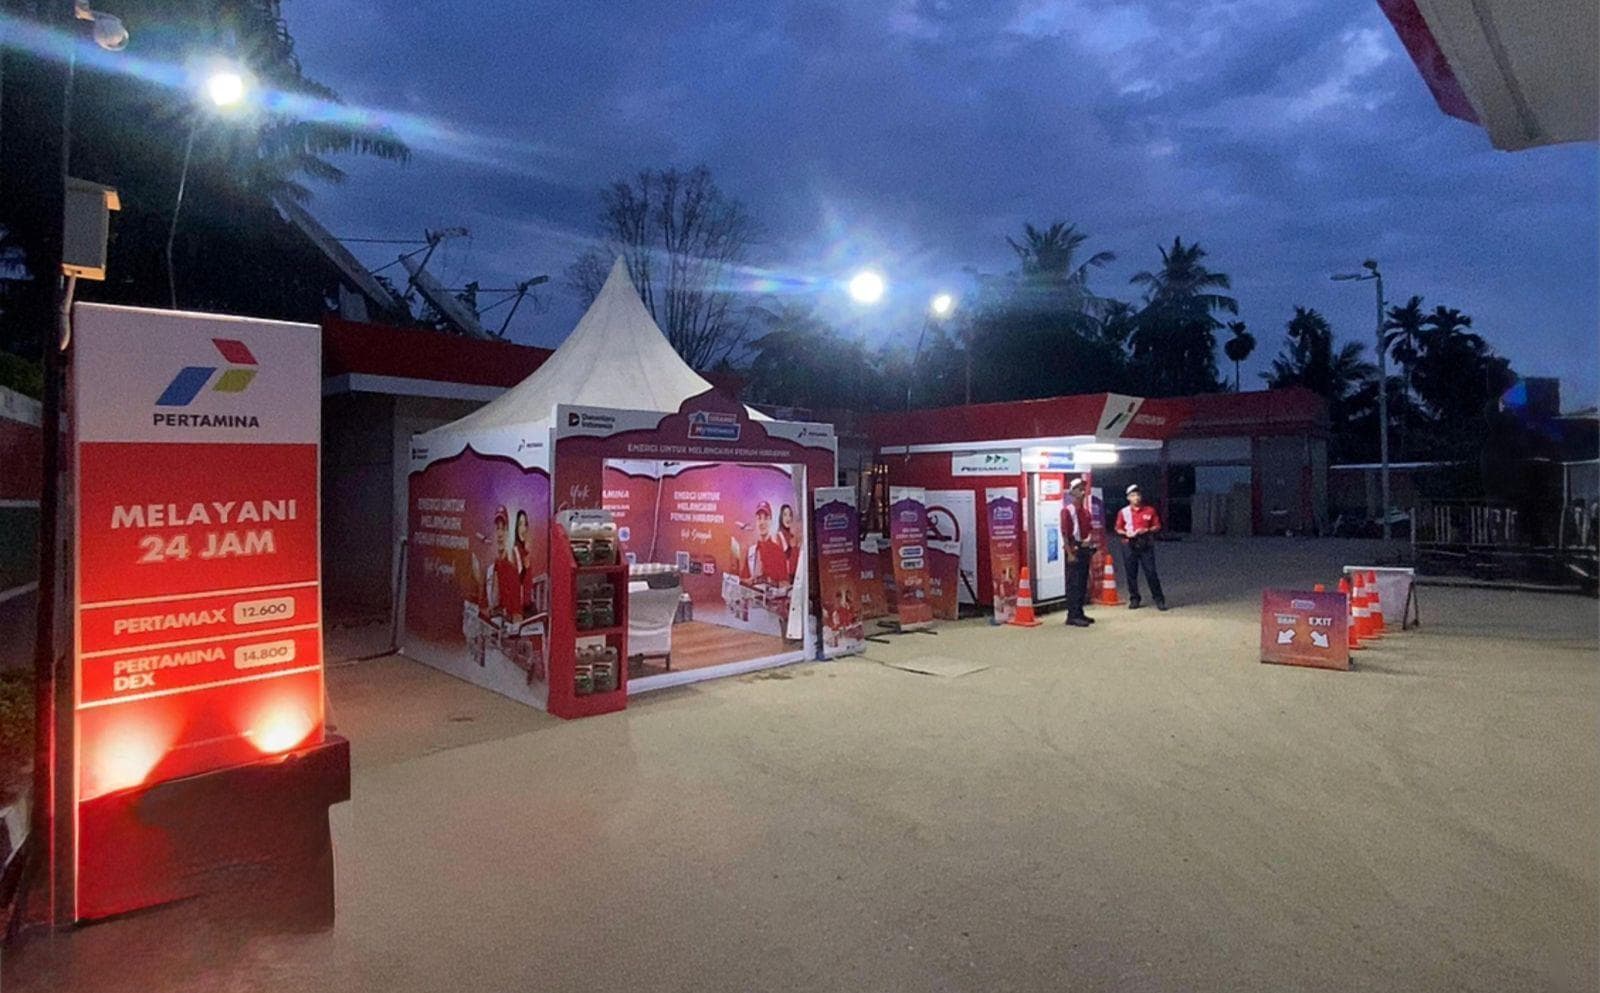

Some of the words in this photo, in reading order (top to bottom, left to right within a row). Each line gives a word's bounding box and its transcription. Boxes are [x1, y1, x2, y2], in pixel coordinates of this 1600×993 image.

[153, 414, 259, 427] PERTAMINA
[111, 500, 297, 529] MELAYANI
[138, 533, 190, 564] 24
[201, 530, 275, 558] JAM
[114, 608, 226, 635] PERTAMAX
[242, 603, 287, 618] 12.600
[1309, 617, 1332, 626] EXIT
[114, 647, 226, 676] PERTAMINA
[242, 646, 288, 662] 14.800
[113, 672, 155, 691] DEX
